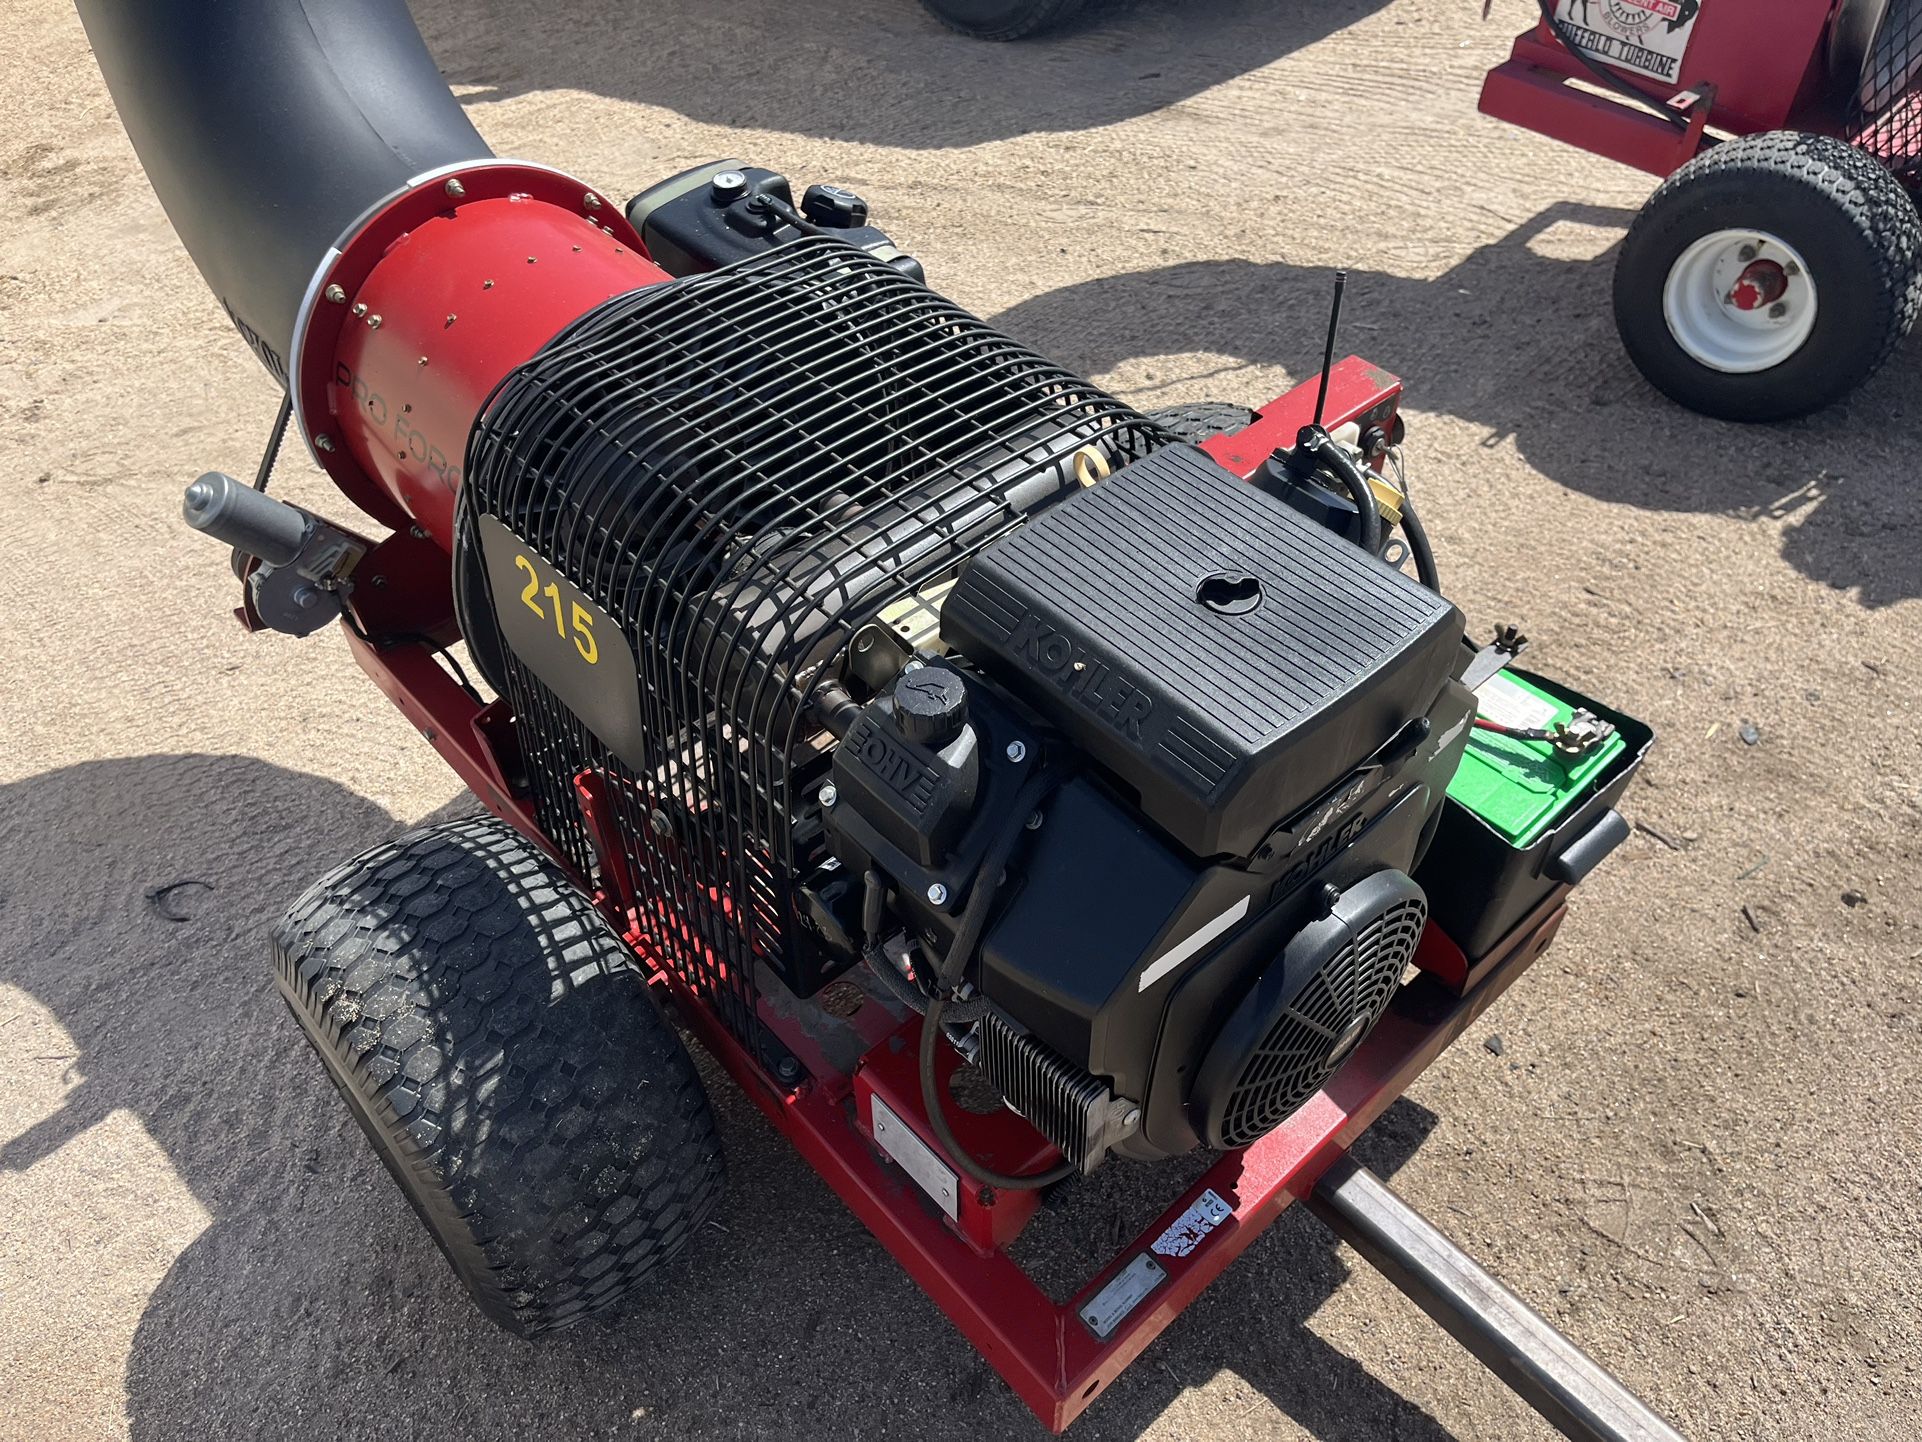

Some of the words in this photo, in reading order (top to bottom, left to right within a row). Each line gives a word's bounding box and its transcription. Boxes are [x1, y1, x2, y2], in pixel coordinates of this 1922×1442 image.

[1603, 11, 1650, 35] BLOWERS
[1655, 2, 1676, 16] AIR
[1618, 40, 1679, 79] TURBINE
[336, 360, 388, 426] PRO
[393, 412, 462, 495] FORC
[515, 554, 598, 665] 215
[1004, 612, 1153, 748] KOHLER
